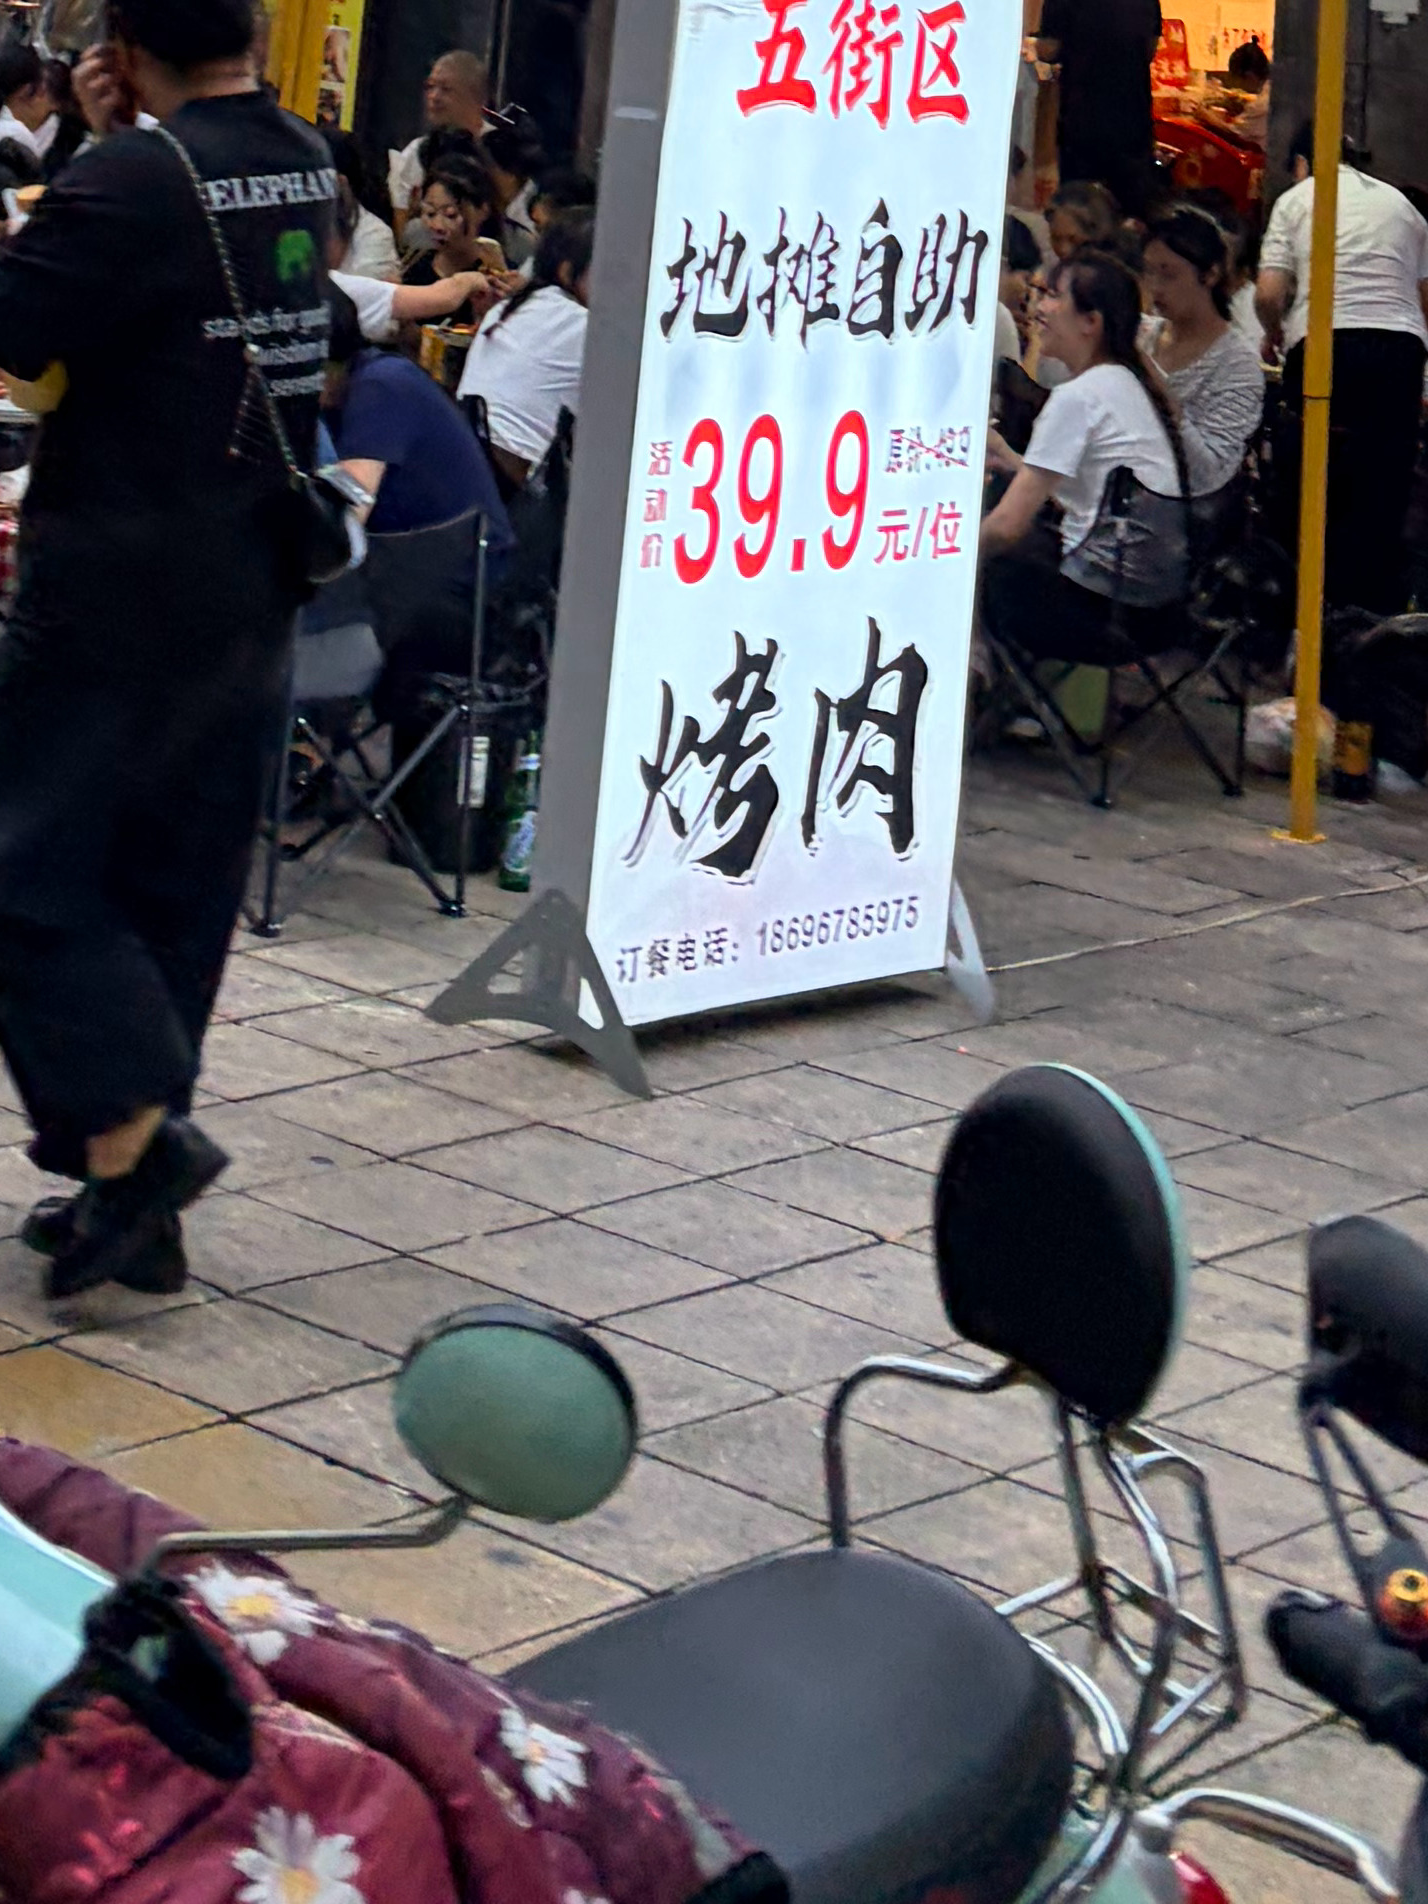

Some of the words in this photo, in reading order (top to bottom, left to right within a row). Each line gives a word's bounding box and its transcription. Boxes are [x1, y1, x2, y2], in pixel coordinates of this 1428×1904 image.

[660, 196, 990, 353] 地摊自助
[674, 409, 870, 585] 39.9
[873, 500, 964, 565] 元/位
[619, 614, 933, 886] 烤肉
[756, 894, 920, 957] 18696785975
